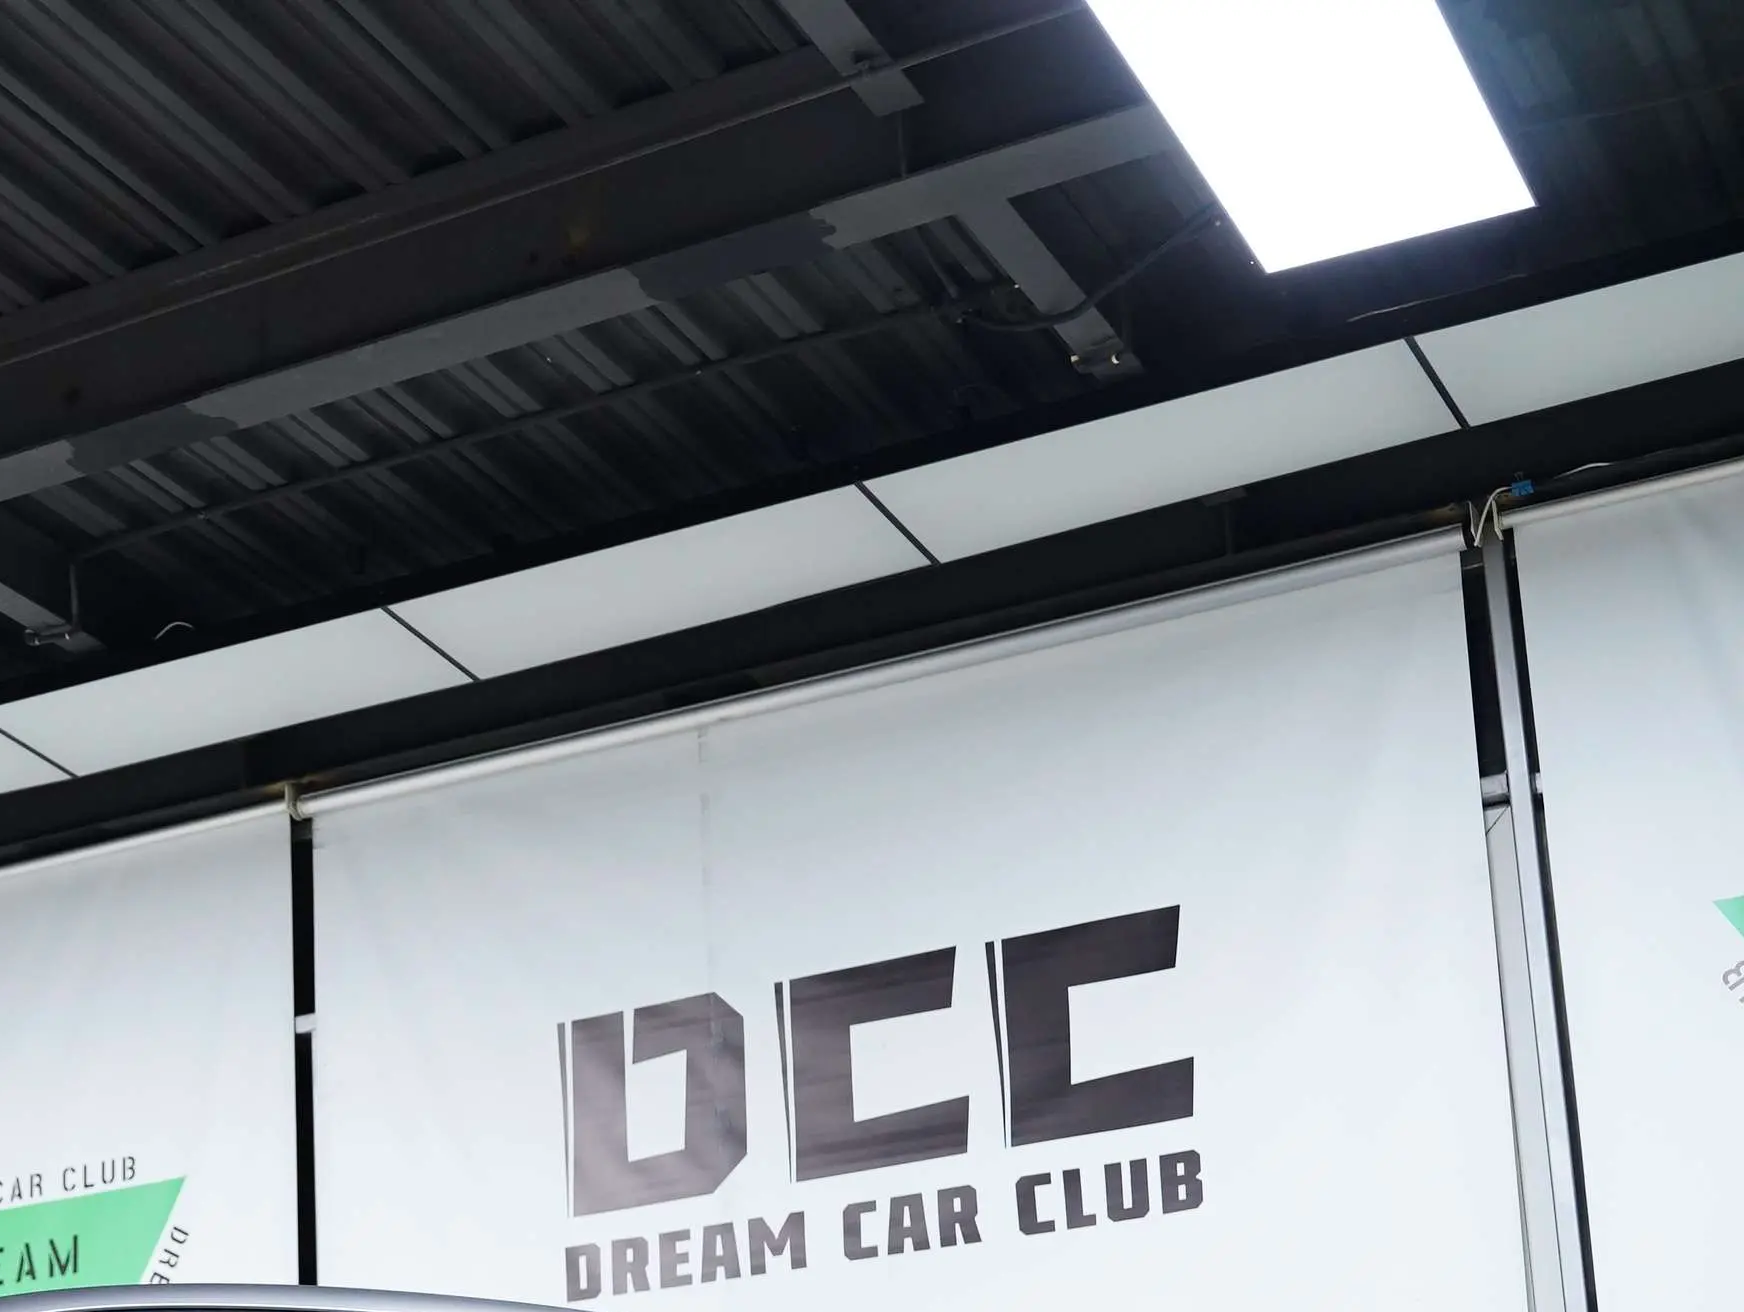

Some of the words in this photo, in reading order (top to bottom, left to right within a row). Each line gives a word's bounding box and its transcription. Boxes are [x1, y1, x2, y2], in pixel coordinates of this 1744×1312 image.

[556, 903, 1195, 1218] DCC
[62, 1155, 136, 1192] CLUB
[564, 1210, 808, 1303] DREAM
[842, 1184, 983, 1261] CAR
[1015, 1149, 1204, 1236] CLUB
[149, 1226, 190, 1285] DRE
